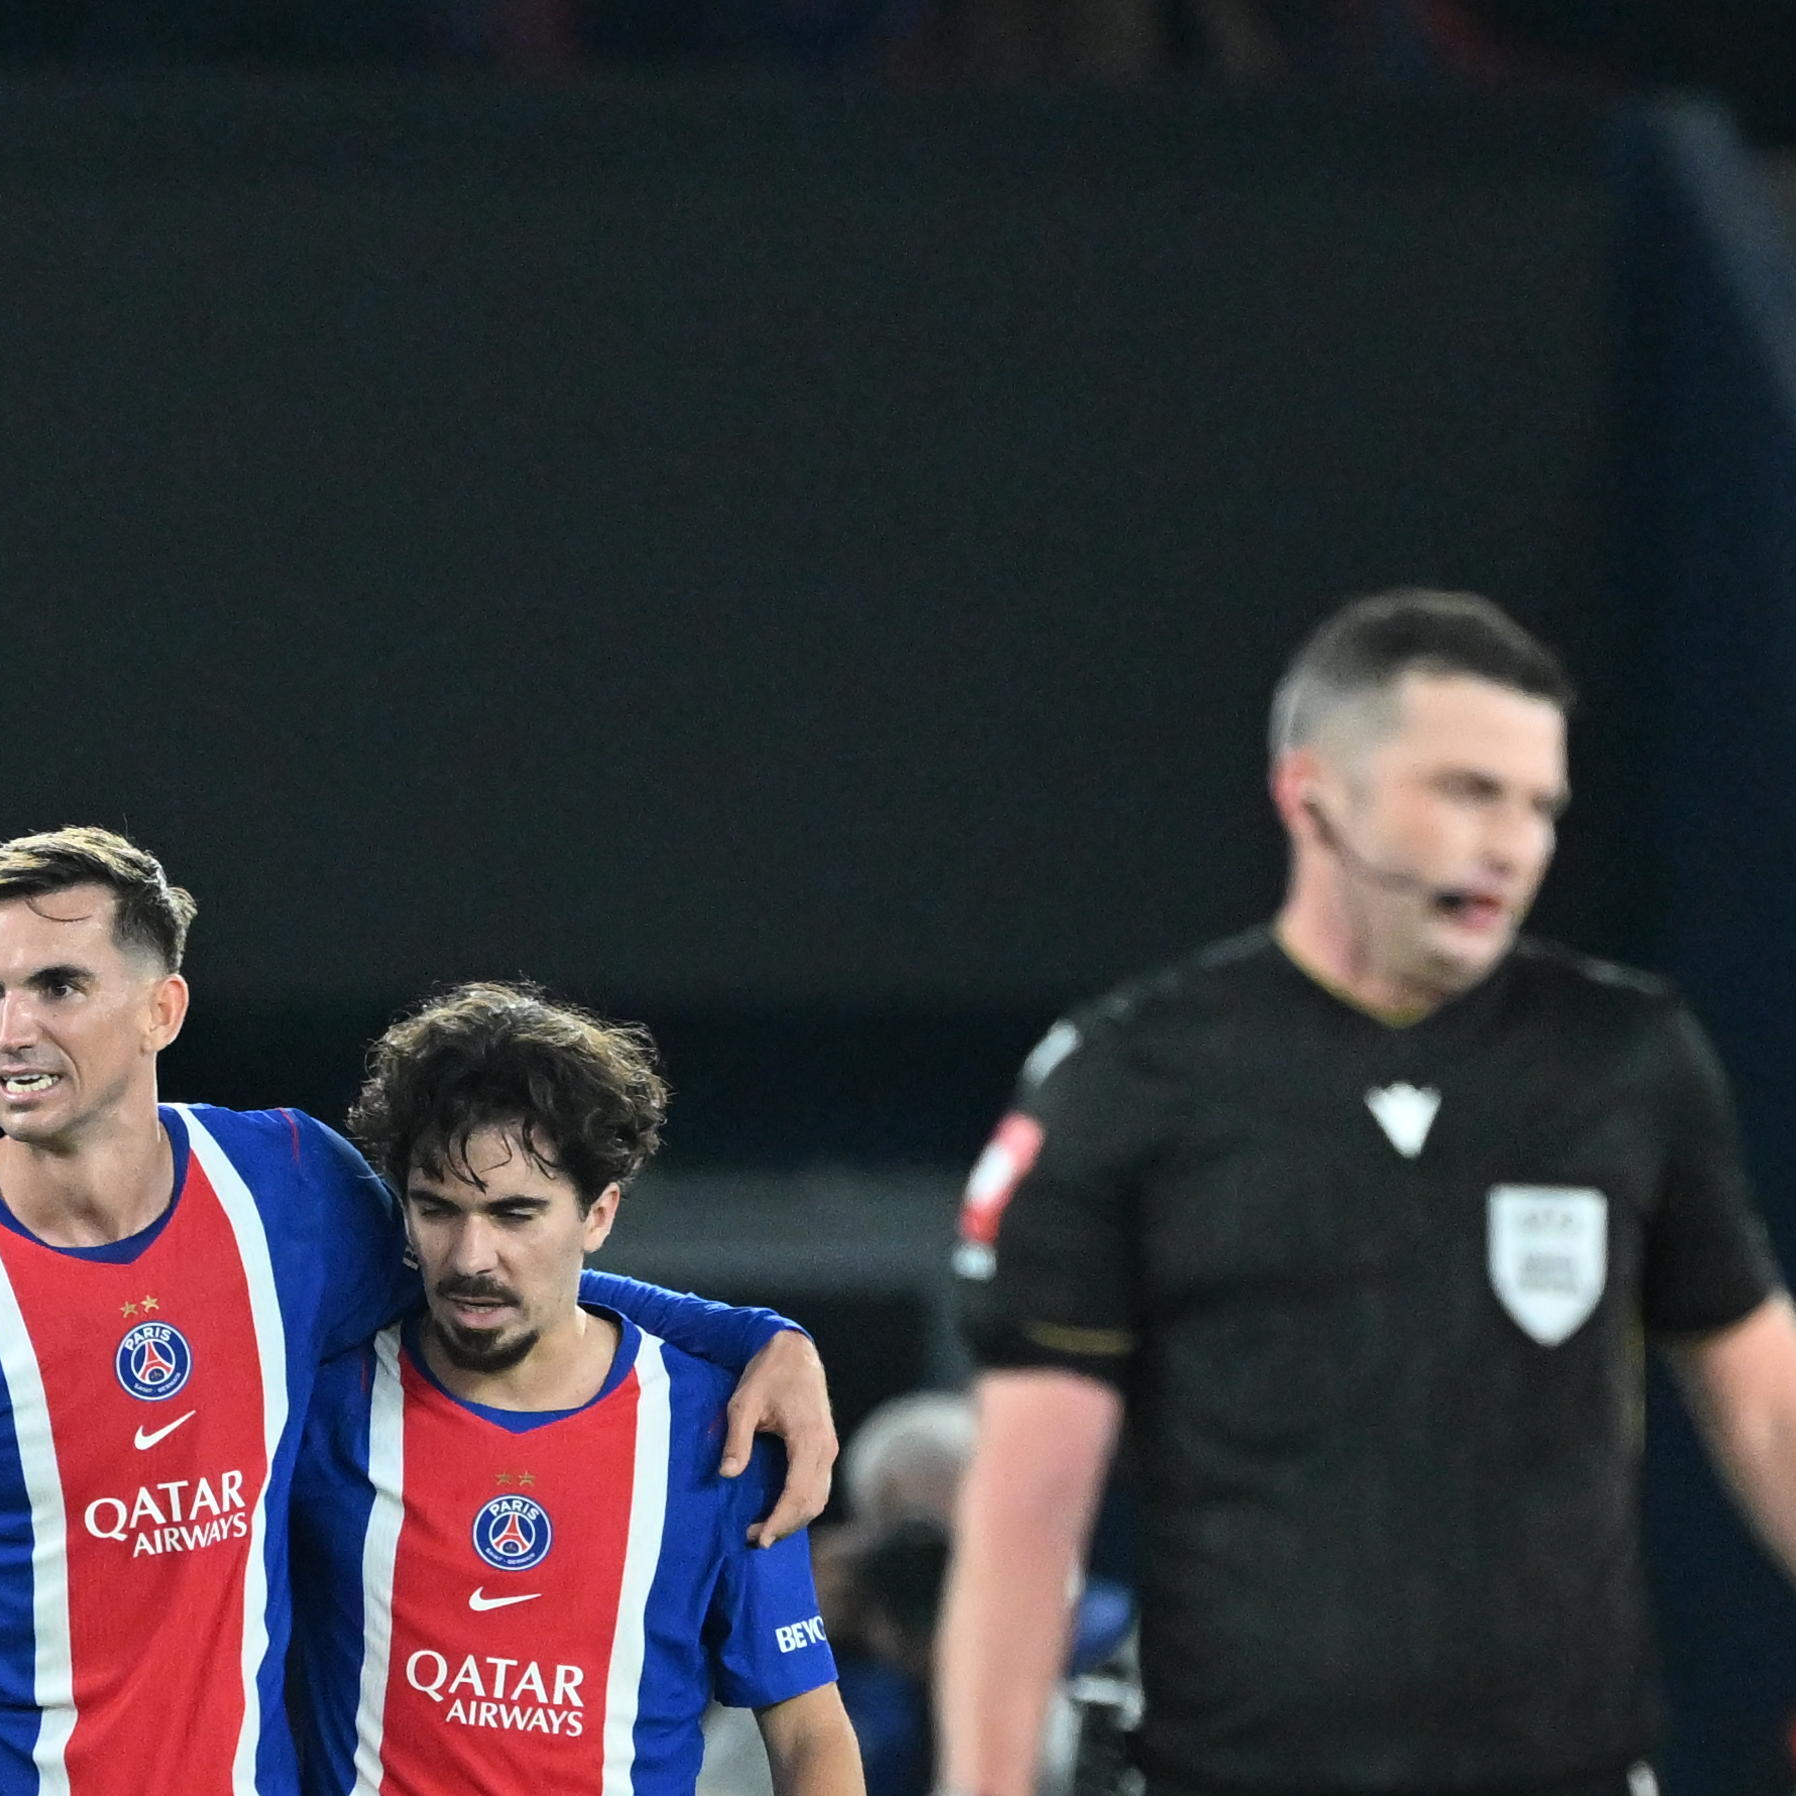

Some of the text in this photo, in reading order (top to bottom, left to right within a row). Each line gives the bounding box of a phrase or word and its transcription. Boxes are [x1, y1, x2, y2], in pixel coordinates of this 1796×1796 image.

[124, 1326, 172, 1351] PARIS
[84, 1470, 245, 1541] QATAR
[488, 1500, 540, 1521] PARIS
[132, 1511, 248, 1558] AIRWAYS
[406, 1650, 585, 1708] QATAR
[445, 1698, 584, 1737] AIRWAYS
